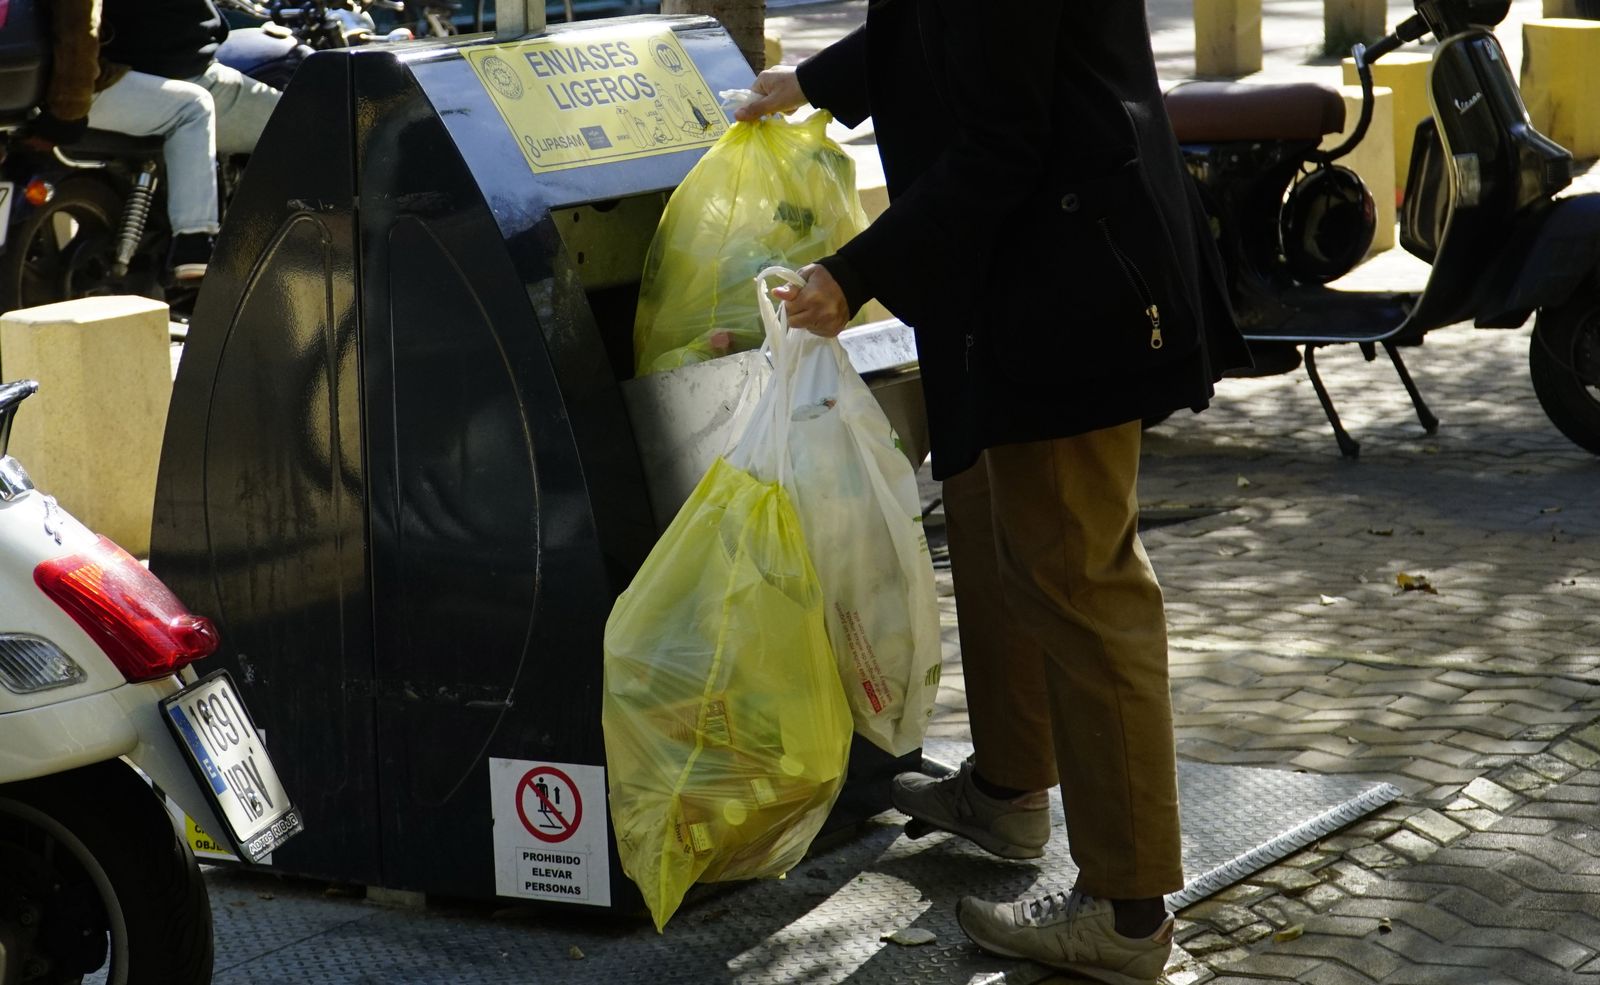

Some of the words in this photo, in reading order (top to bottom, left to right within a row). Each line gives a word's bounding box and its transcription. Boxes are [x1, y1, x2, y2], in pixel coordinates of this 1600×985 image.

[524, 41, 638, 77] ENVASES
[546, 72, 656, 110] LIGEROS
[536, 133, 585, 151] LIPASAM
[202, 758, 217, 779] E
[223, 756, 274, 823] HBV
[523, 852, 580, 865] PROHIBIDO
[532, 867, 573, 880] ELEVAR
[525, 881, 580, 895] PERSONAS
